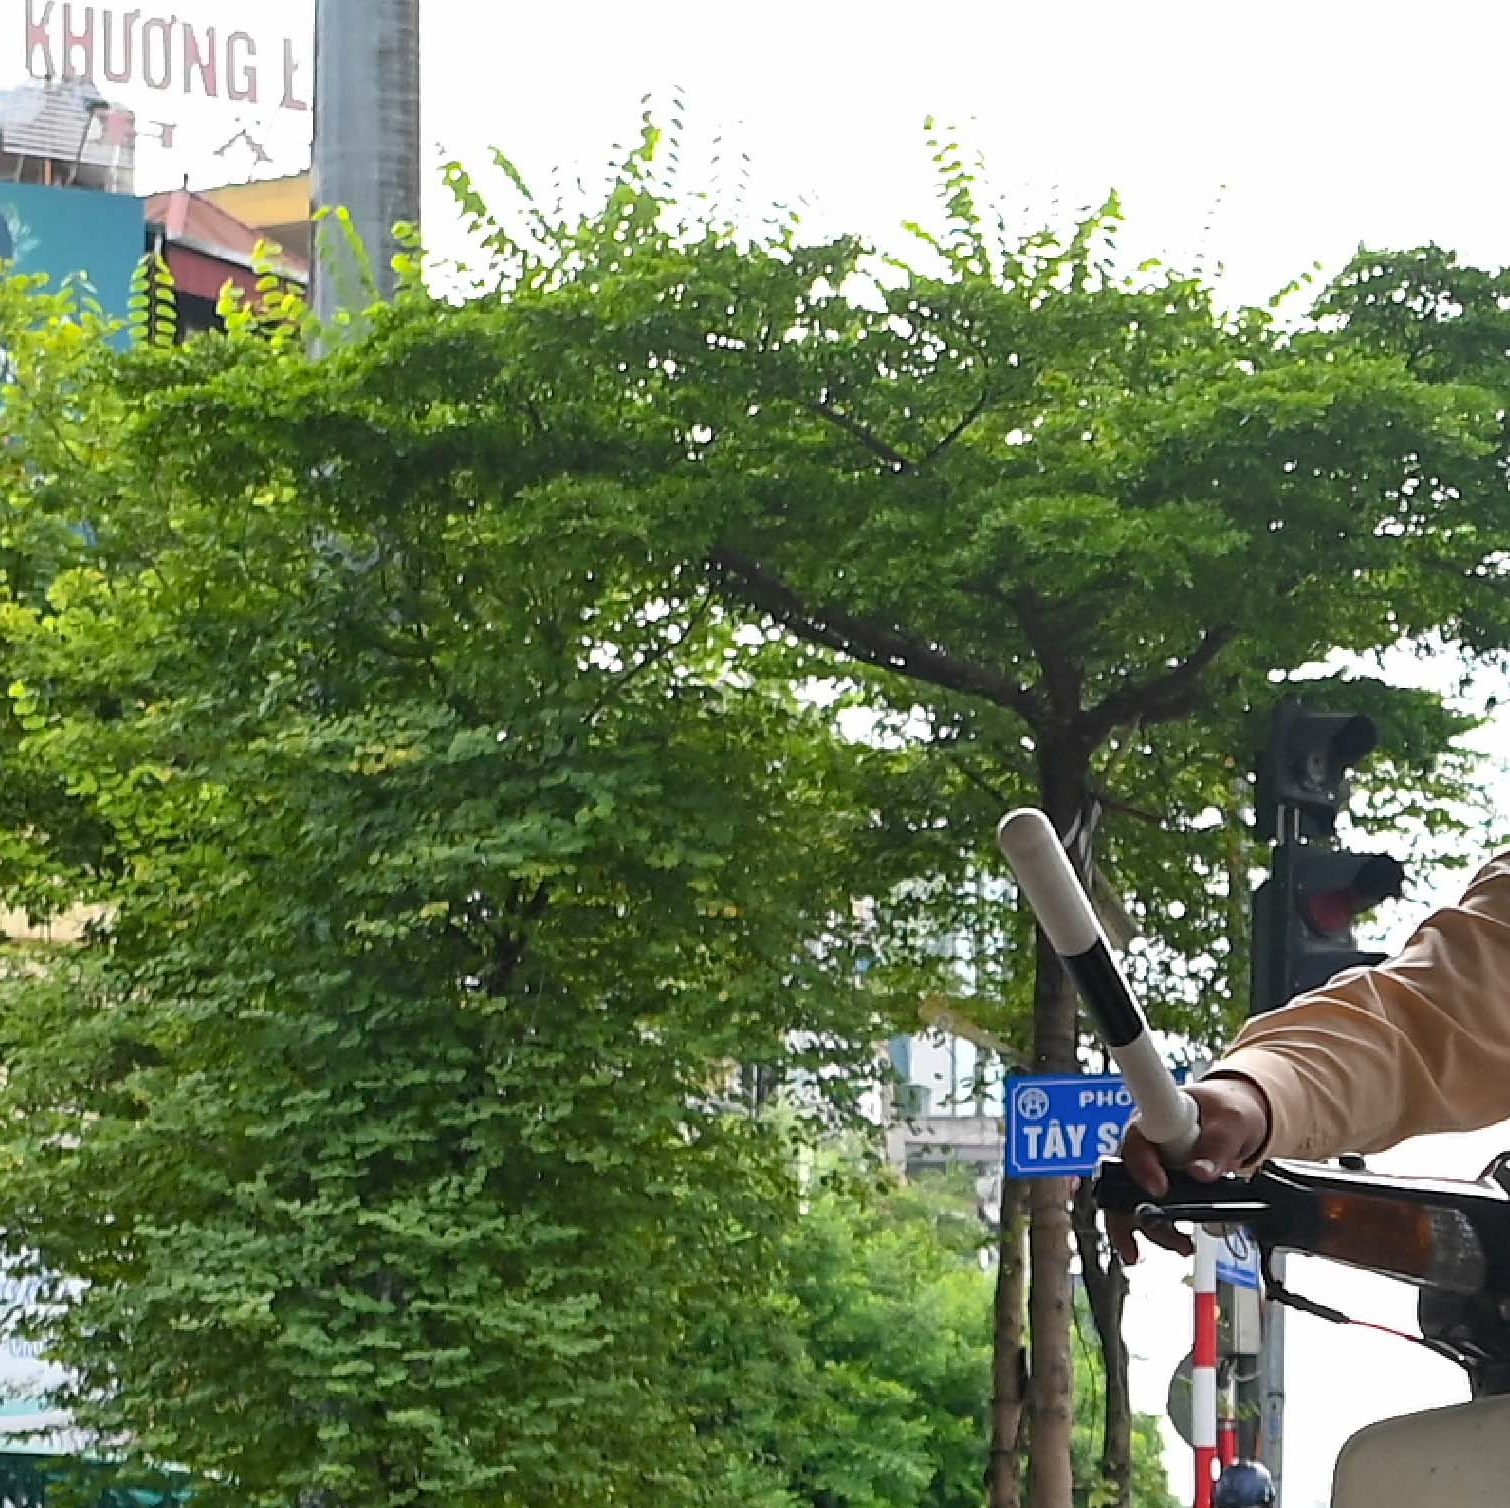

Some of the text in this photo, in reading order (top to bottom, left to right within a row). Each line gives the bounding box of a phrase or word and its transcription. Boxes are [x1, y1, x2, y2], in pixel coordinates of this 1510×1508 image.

[25, 0, 259, 104] KHƯƠNG
[1022, 1118, 1129, 1160] TÂY S
